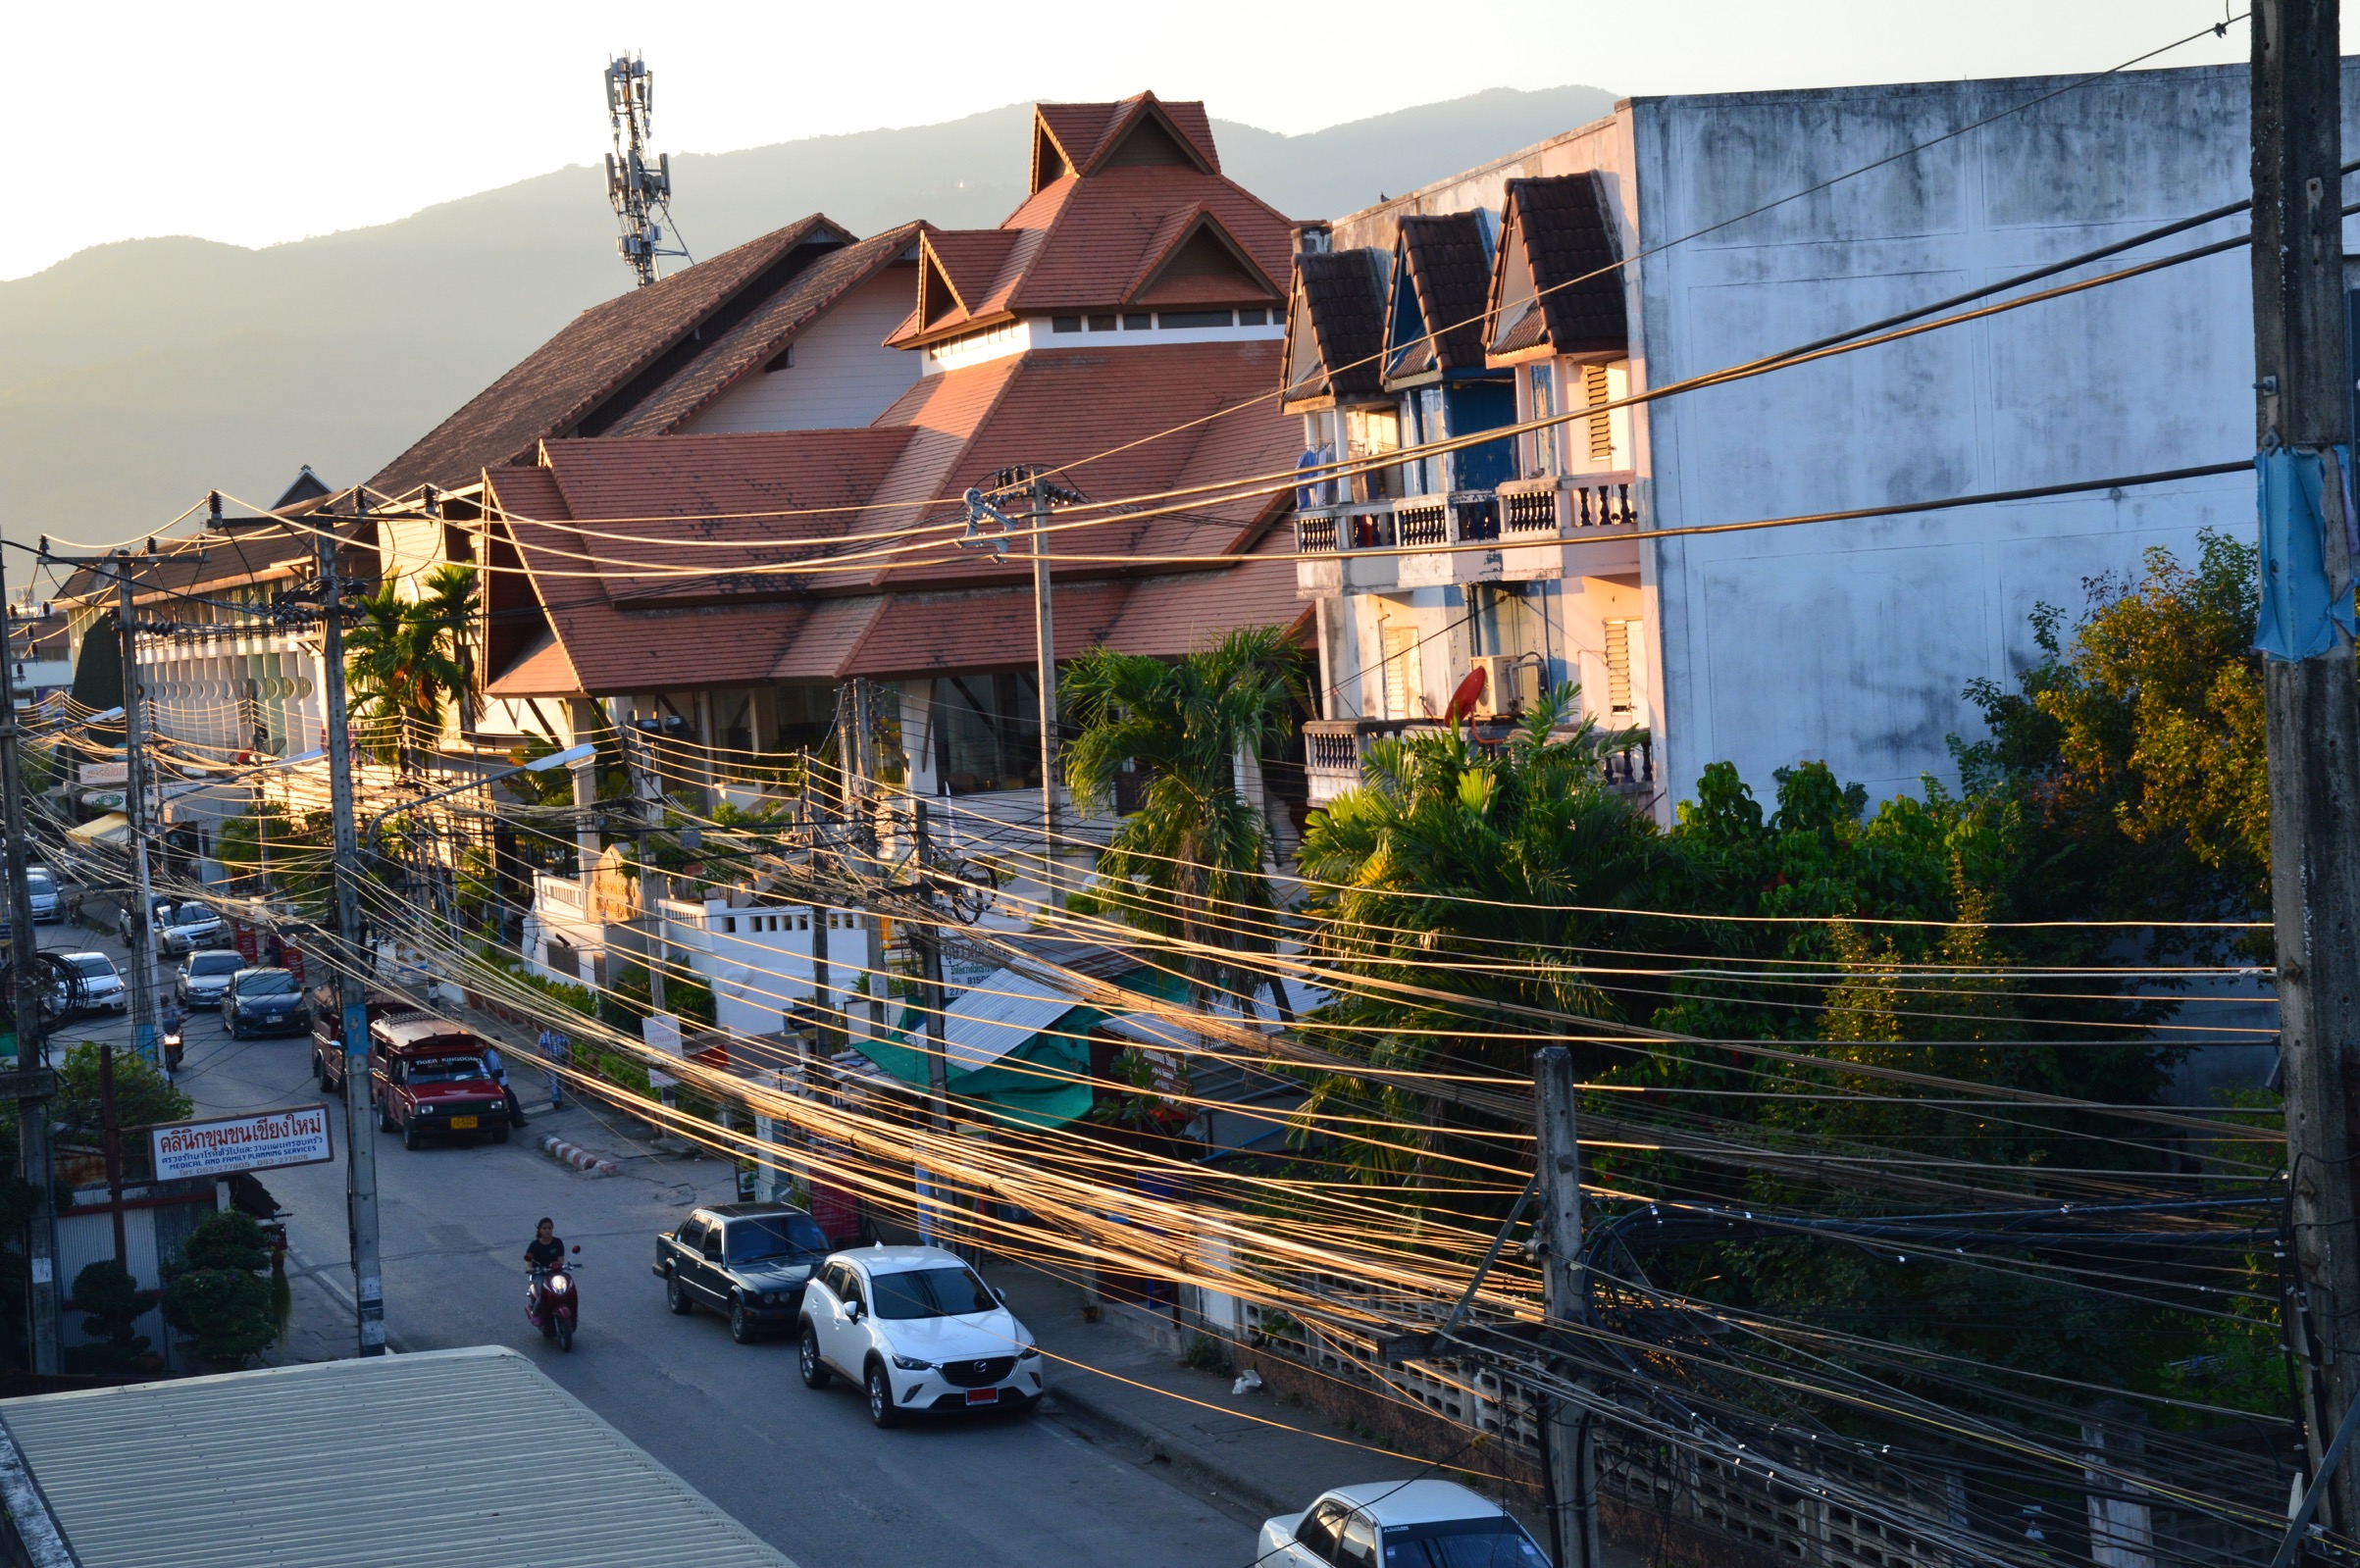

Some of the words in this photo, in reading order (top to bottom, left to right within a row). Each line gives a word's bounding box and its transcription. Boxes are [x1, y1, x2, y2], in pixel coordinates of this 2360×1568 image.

[160, 1113, 322, 1153] คลินิกชุมชนเชียงใหม่
[169, 1159, 203, 1170] MEDICAL
[204, 1157, 221, 1167] AND
[222, 1154, 246, 1164] FAMILY
[247, 1150, 282, 1161] PLANNING
[283, 1145, 317, 1156] SERVICES
